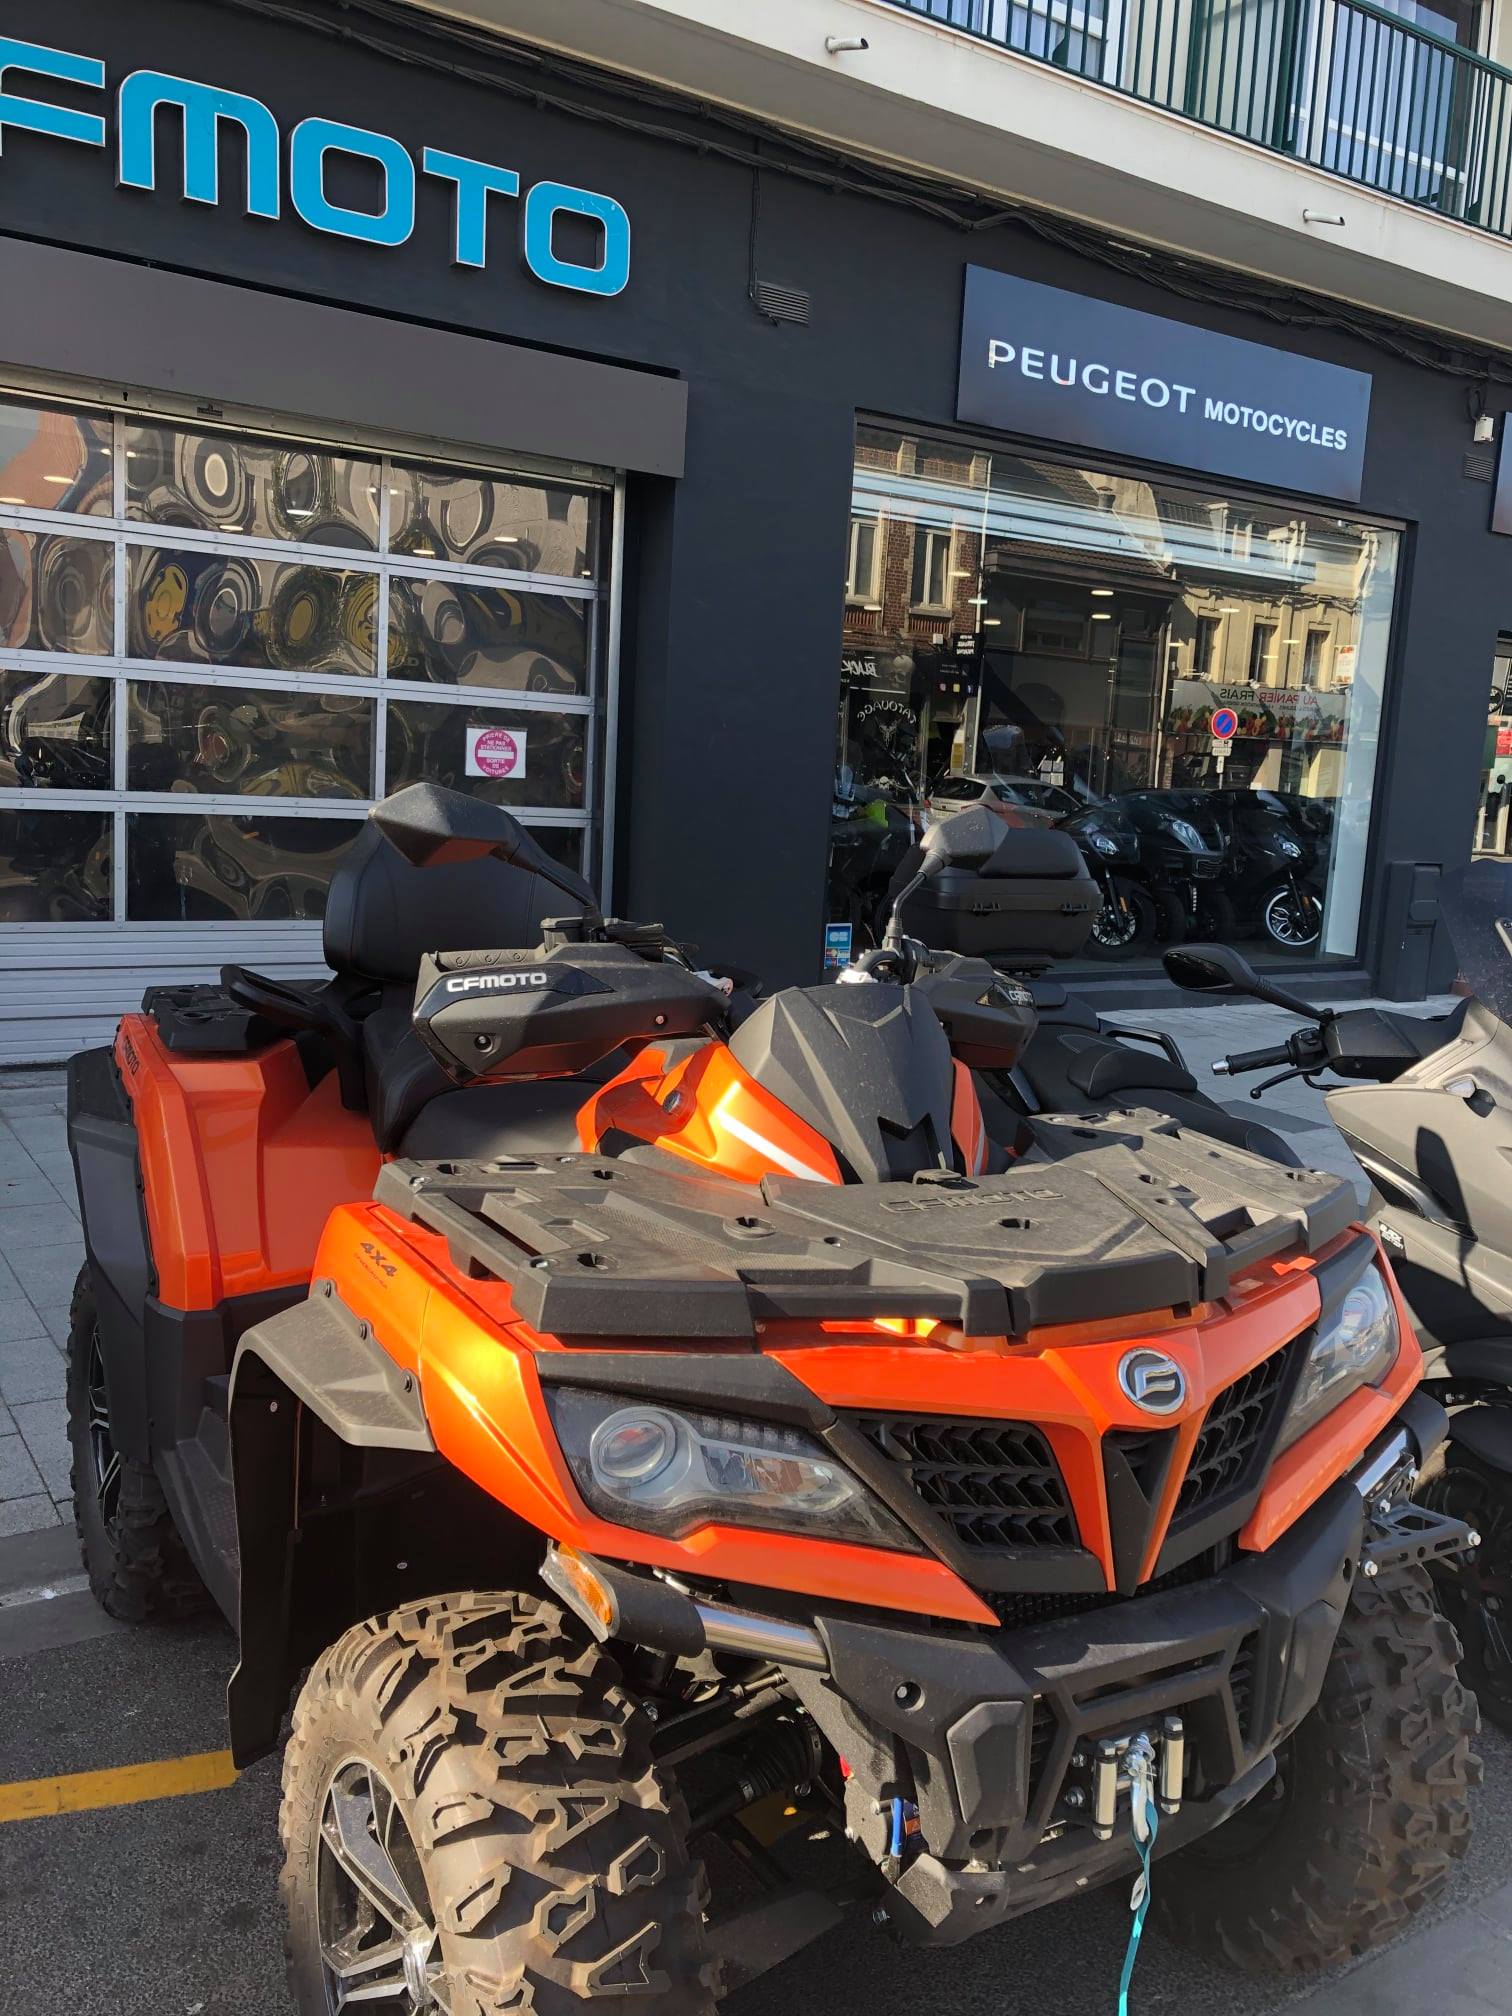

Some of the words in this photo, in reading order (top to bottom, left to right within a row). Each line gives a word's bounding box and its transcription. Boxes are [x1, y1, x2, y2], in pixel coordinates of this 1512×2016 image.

[988, 338, 1197, 413] PEUGEOT
[1204, 397, 1348, 451] MOTOCYCLES
[447, 971, 547, 993] CFMOTO
[879, 1188, 1066, 1213] CFMOTO
